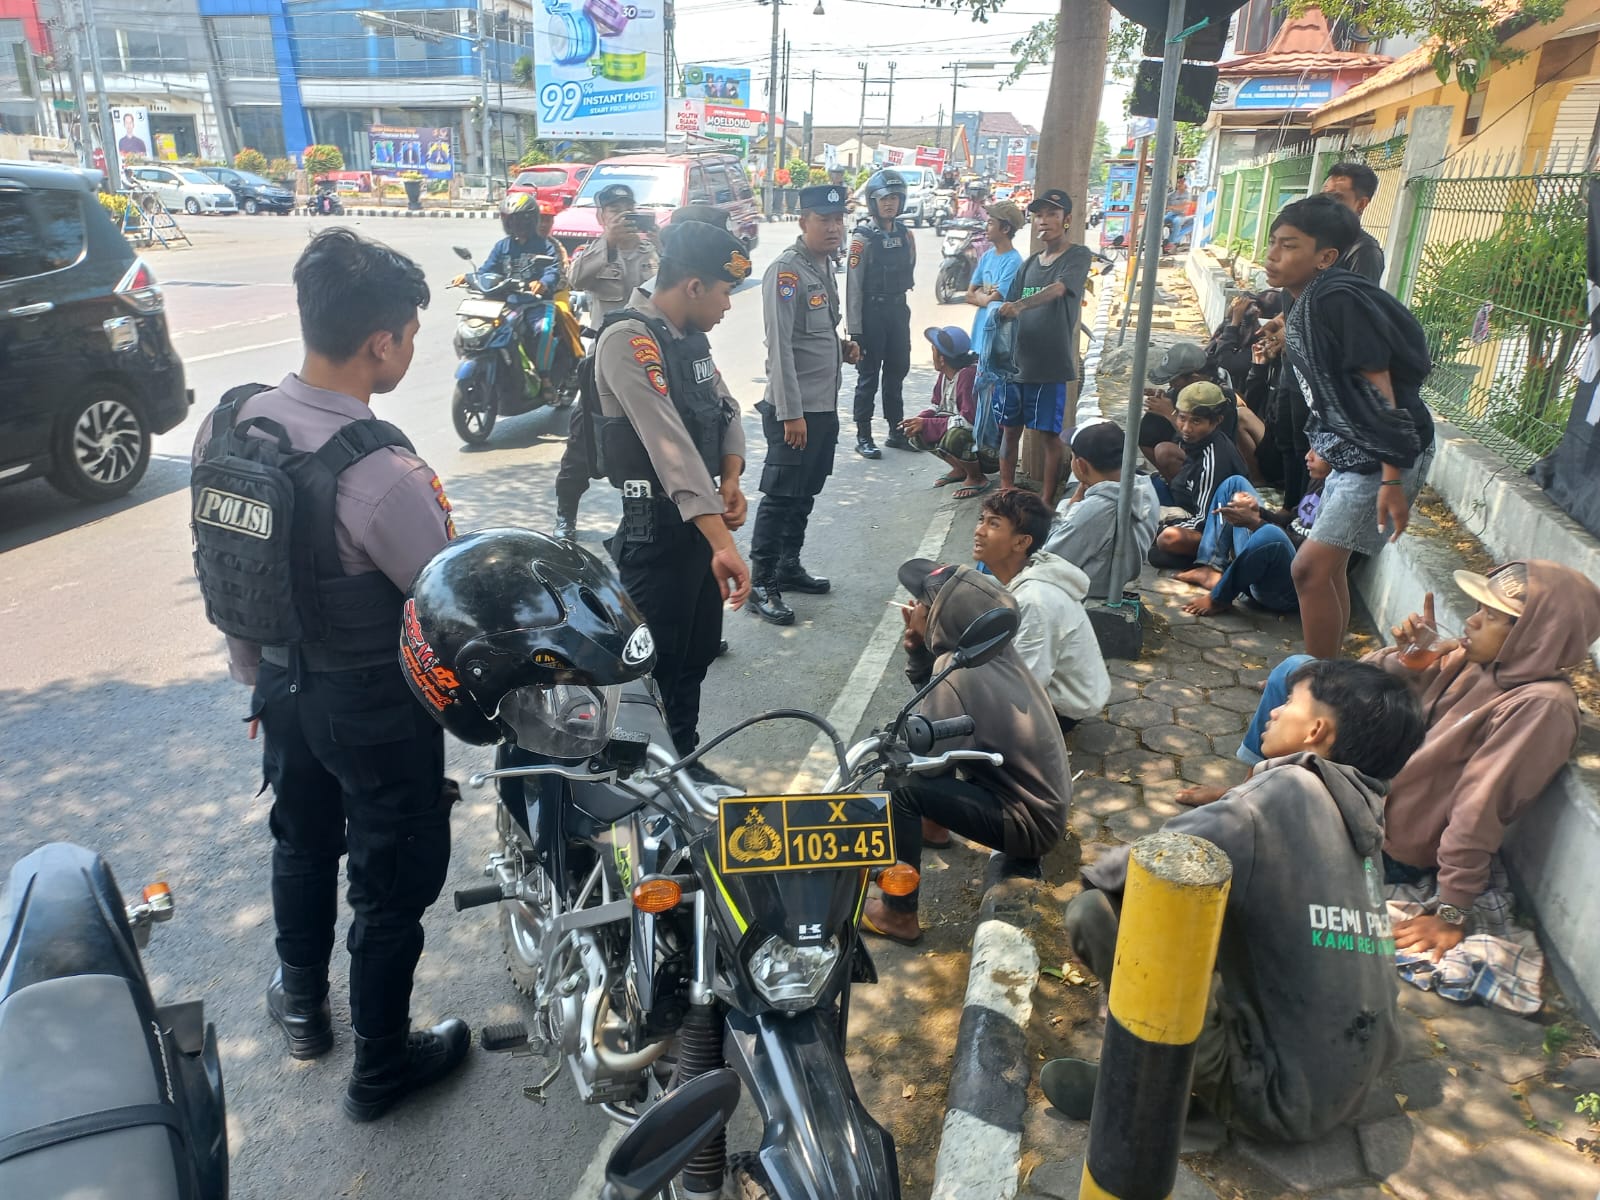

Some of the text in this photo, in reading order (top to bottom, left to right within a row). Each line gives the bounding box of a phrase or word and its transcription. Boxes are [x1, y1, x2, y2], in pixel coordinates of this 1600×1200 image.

[541, 81, 582, 123] 99
[583, 94, 624, 106] INSTANT
[201, 492, 270, 534] POLISI
[828, 801, 848, 822] X
[792, 830, 886, 862] 103-45
[1309, 904, 1362, 934] DEMI
[1312, 930, 1354, 951] KAMI
